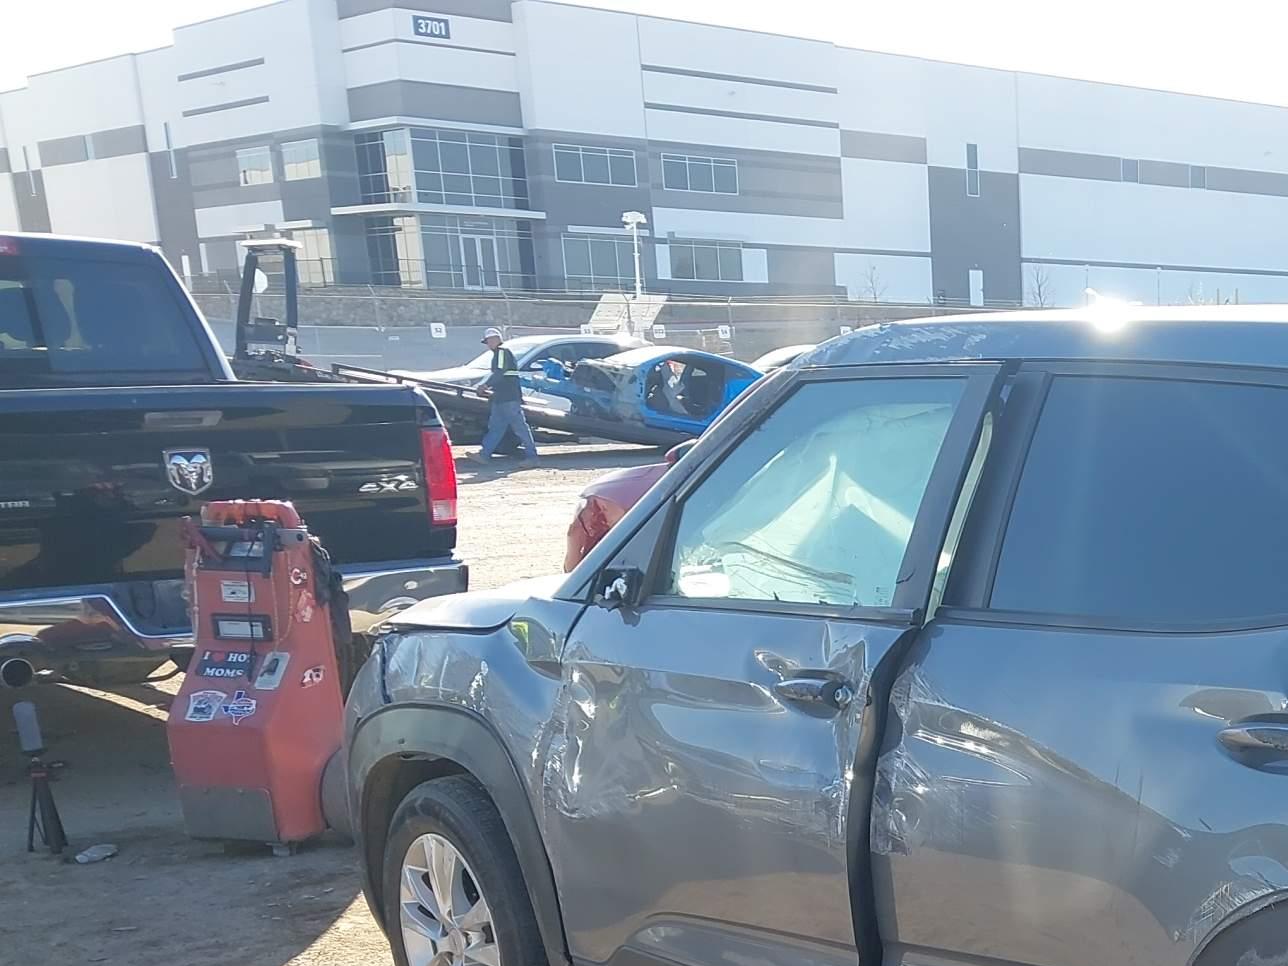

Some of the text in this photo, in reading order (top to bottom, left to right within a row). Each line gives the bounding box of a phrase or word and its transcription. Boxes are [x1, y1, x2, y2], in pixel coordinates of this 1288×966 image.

[417, 18, 447, 36] 3701
[203, 651, 211, 660] I
[203, 667, 245, 678] MOMS
